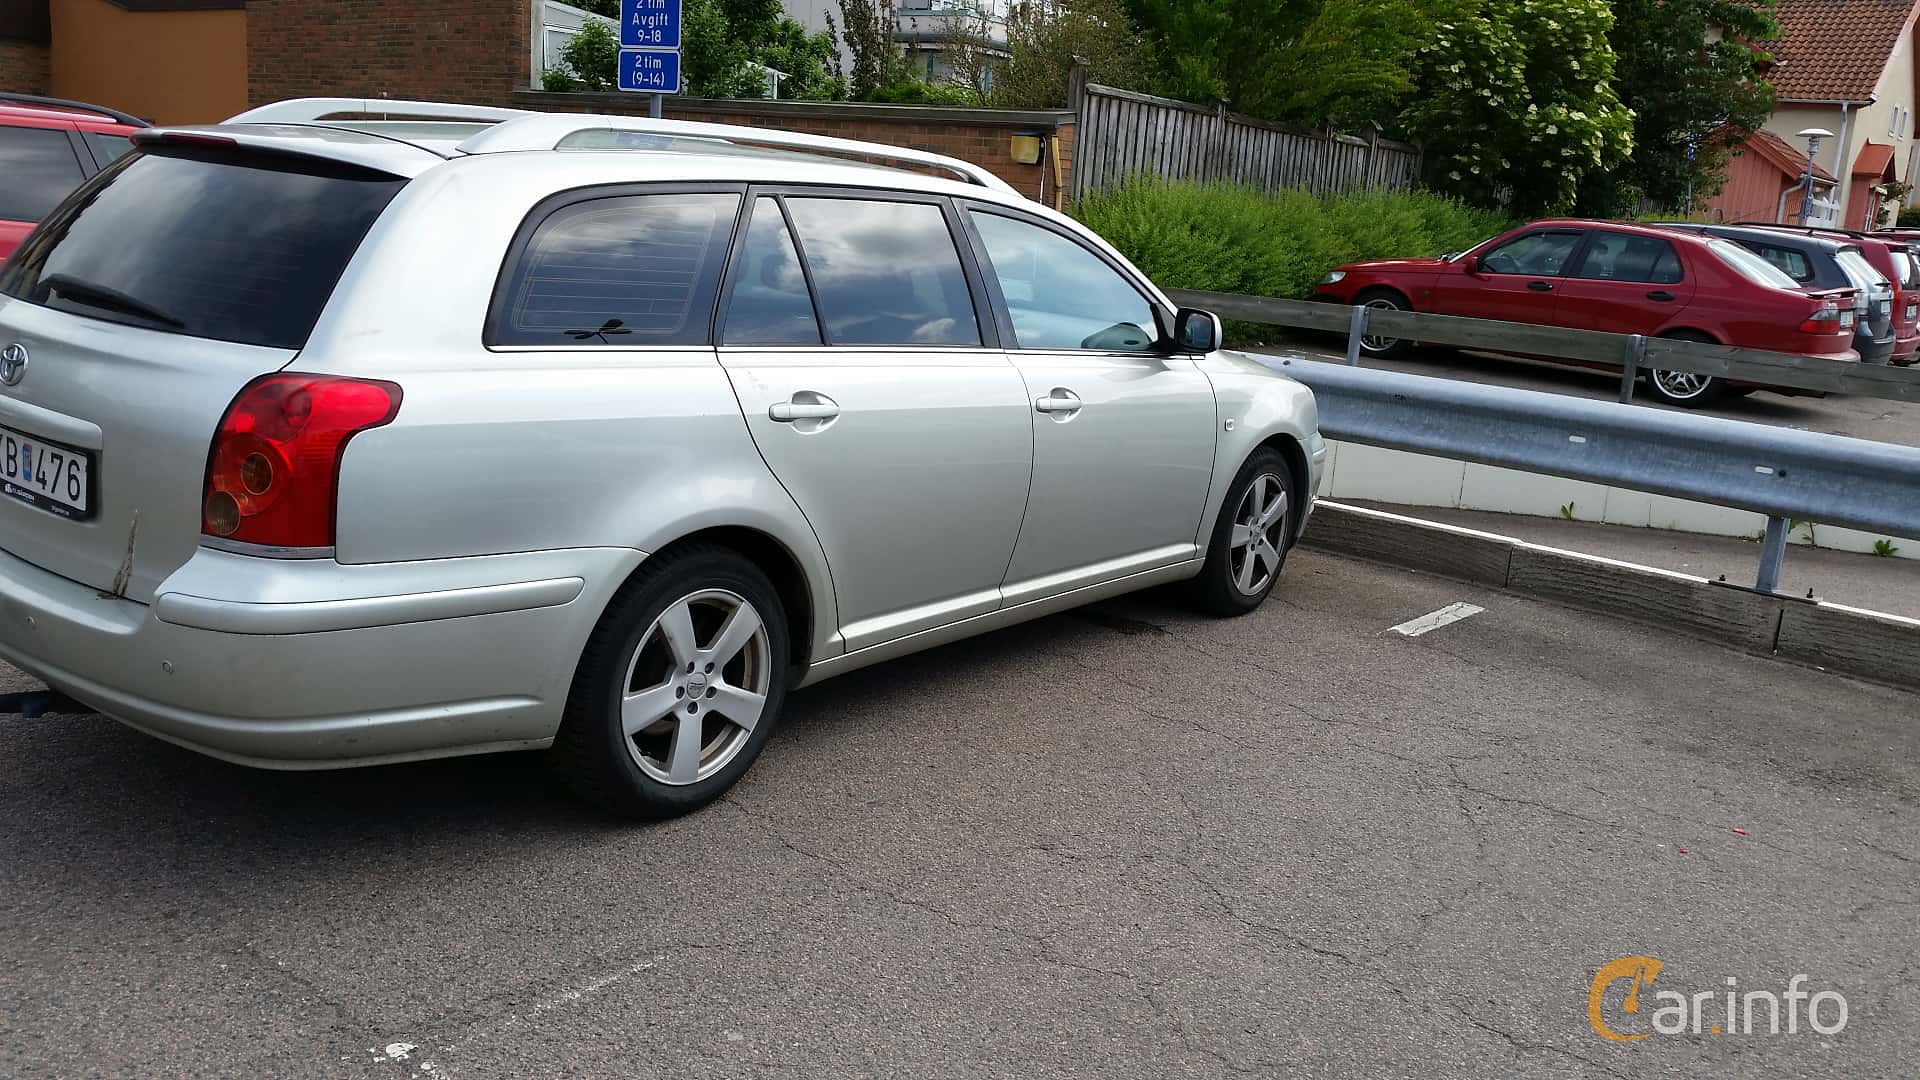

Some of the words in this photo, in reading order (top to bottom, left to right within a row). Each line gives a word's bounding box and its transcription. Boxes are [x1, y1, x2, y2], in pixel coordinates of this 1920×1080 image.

[636, 0, 643, 9] 2
[648, 0, 665, 9] tim
[632, 12, 668, 29] Avgift
[637, 29, 662, 43] 9-18
[635, 54, 642, 68] 2
[644, 55, 662, 69] tim
[632, 70, 665, 87] (9-14)
[35, 448, 81, 502] 476
